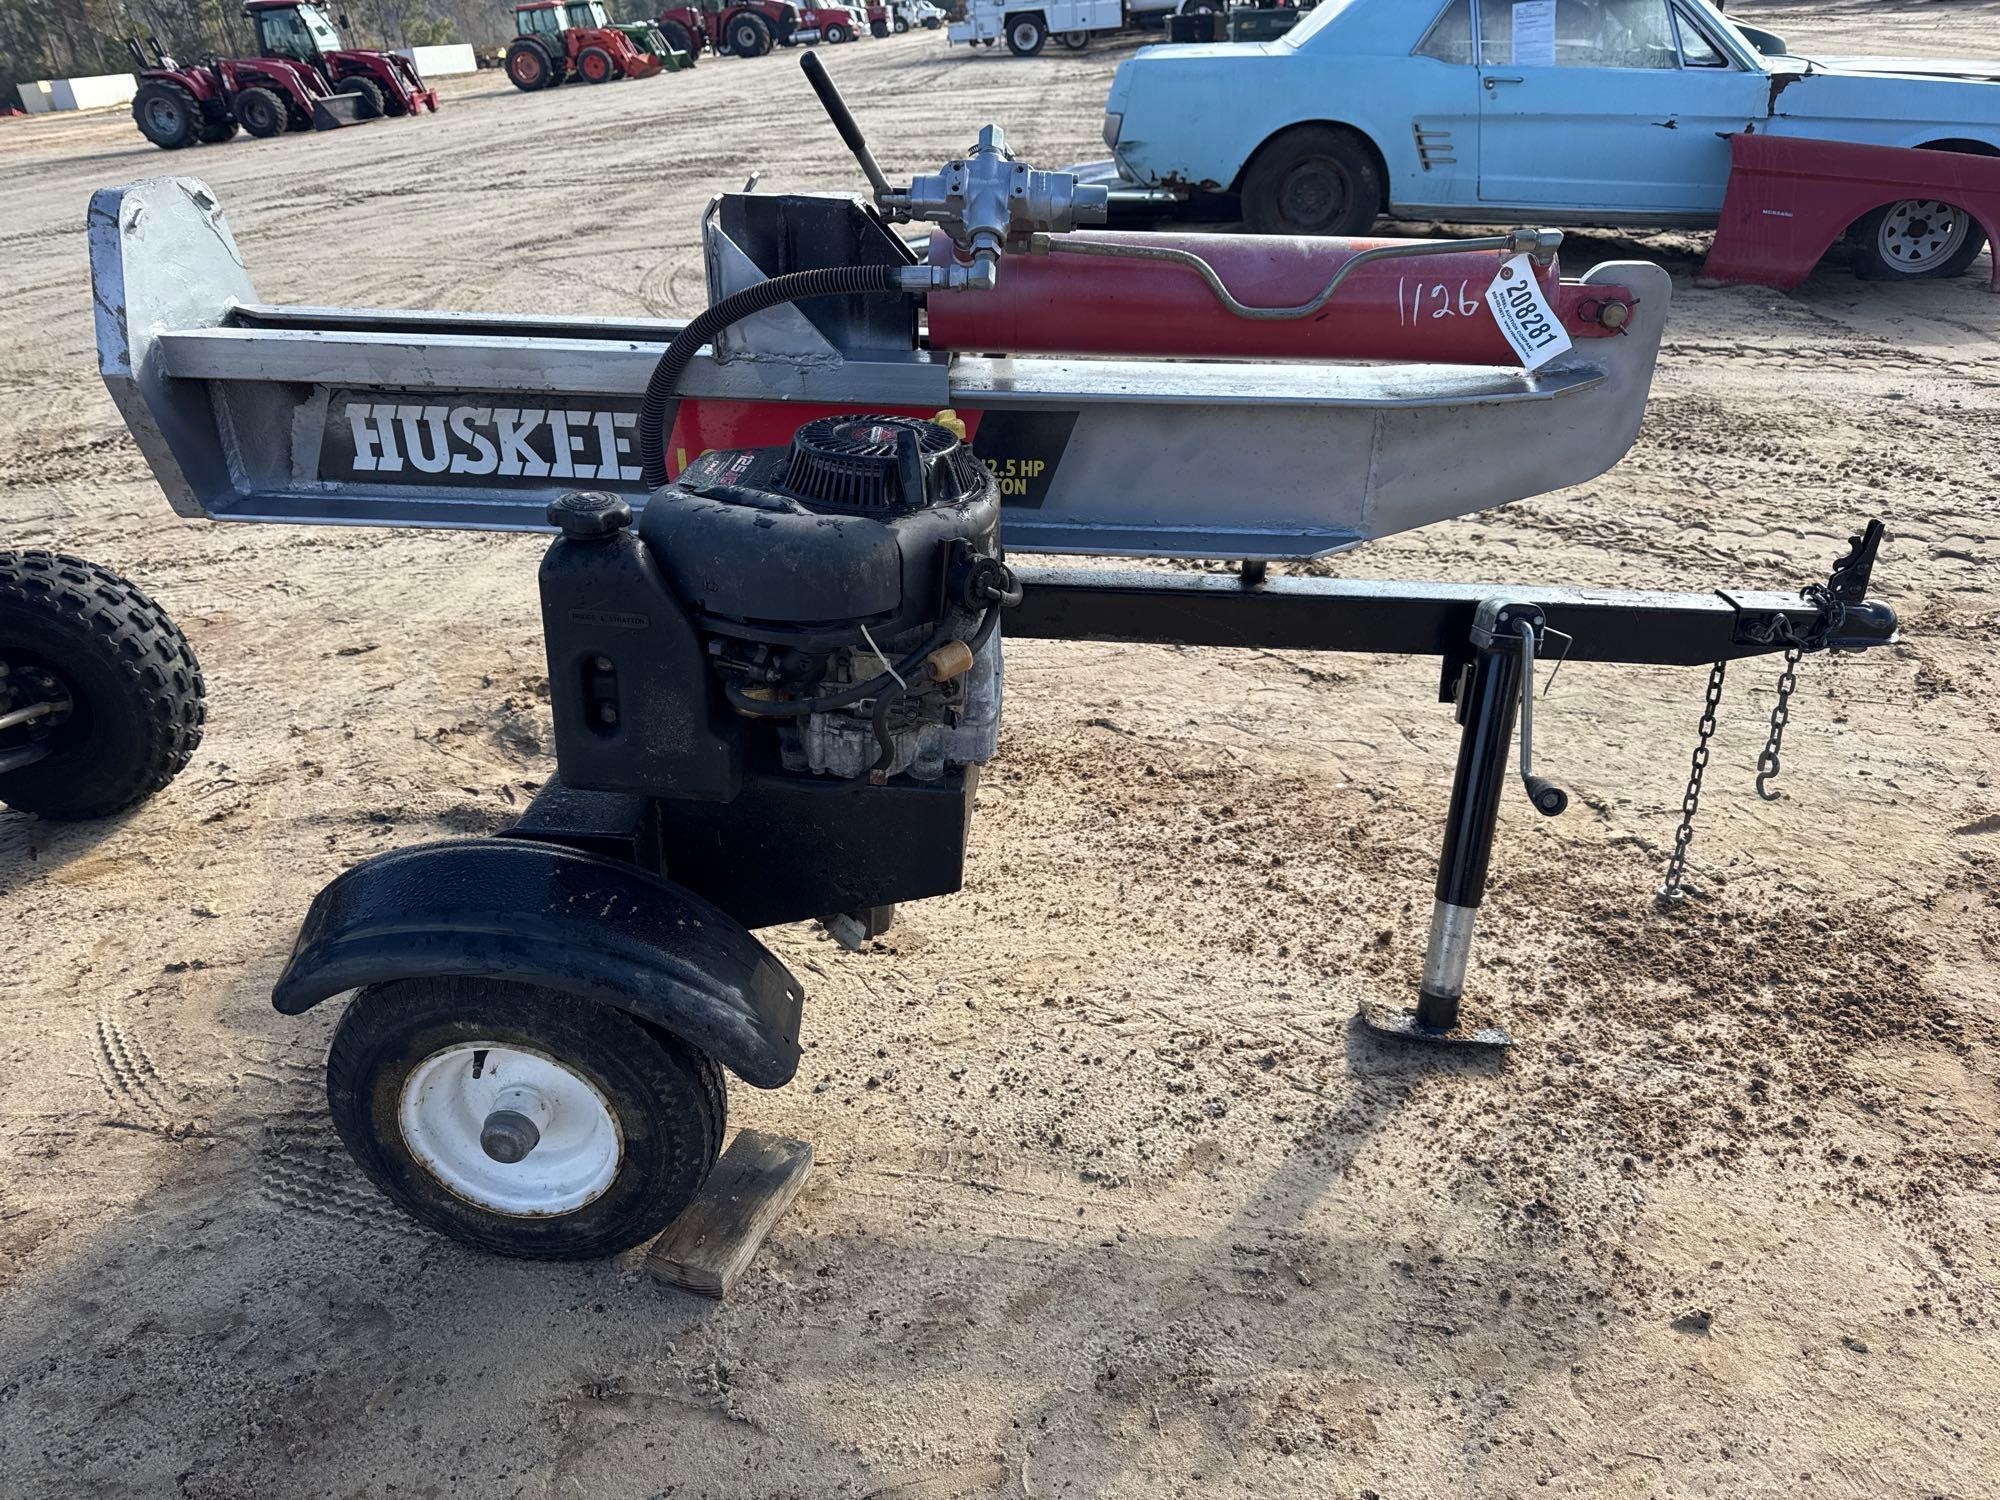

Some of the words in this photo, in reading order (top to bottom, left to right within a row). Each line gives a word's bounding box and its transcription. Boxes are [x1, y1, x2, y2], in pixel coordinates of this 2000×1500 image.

[1398, 276, 1480, 327] 1126
[1498, 292, 1507, 310] REBEL
[1505, 309, 1519, 331] AUCTION
[1516, 330, 1535, 352] COMPANY
[1506, 279, 1558, 349] 208281
[344, 402, 643, 481] HUSKEE
[1020, 459, 1045, 477] HP
